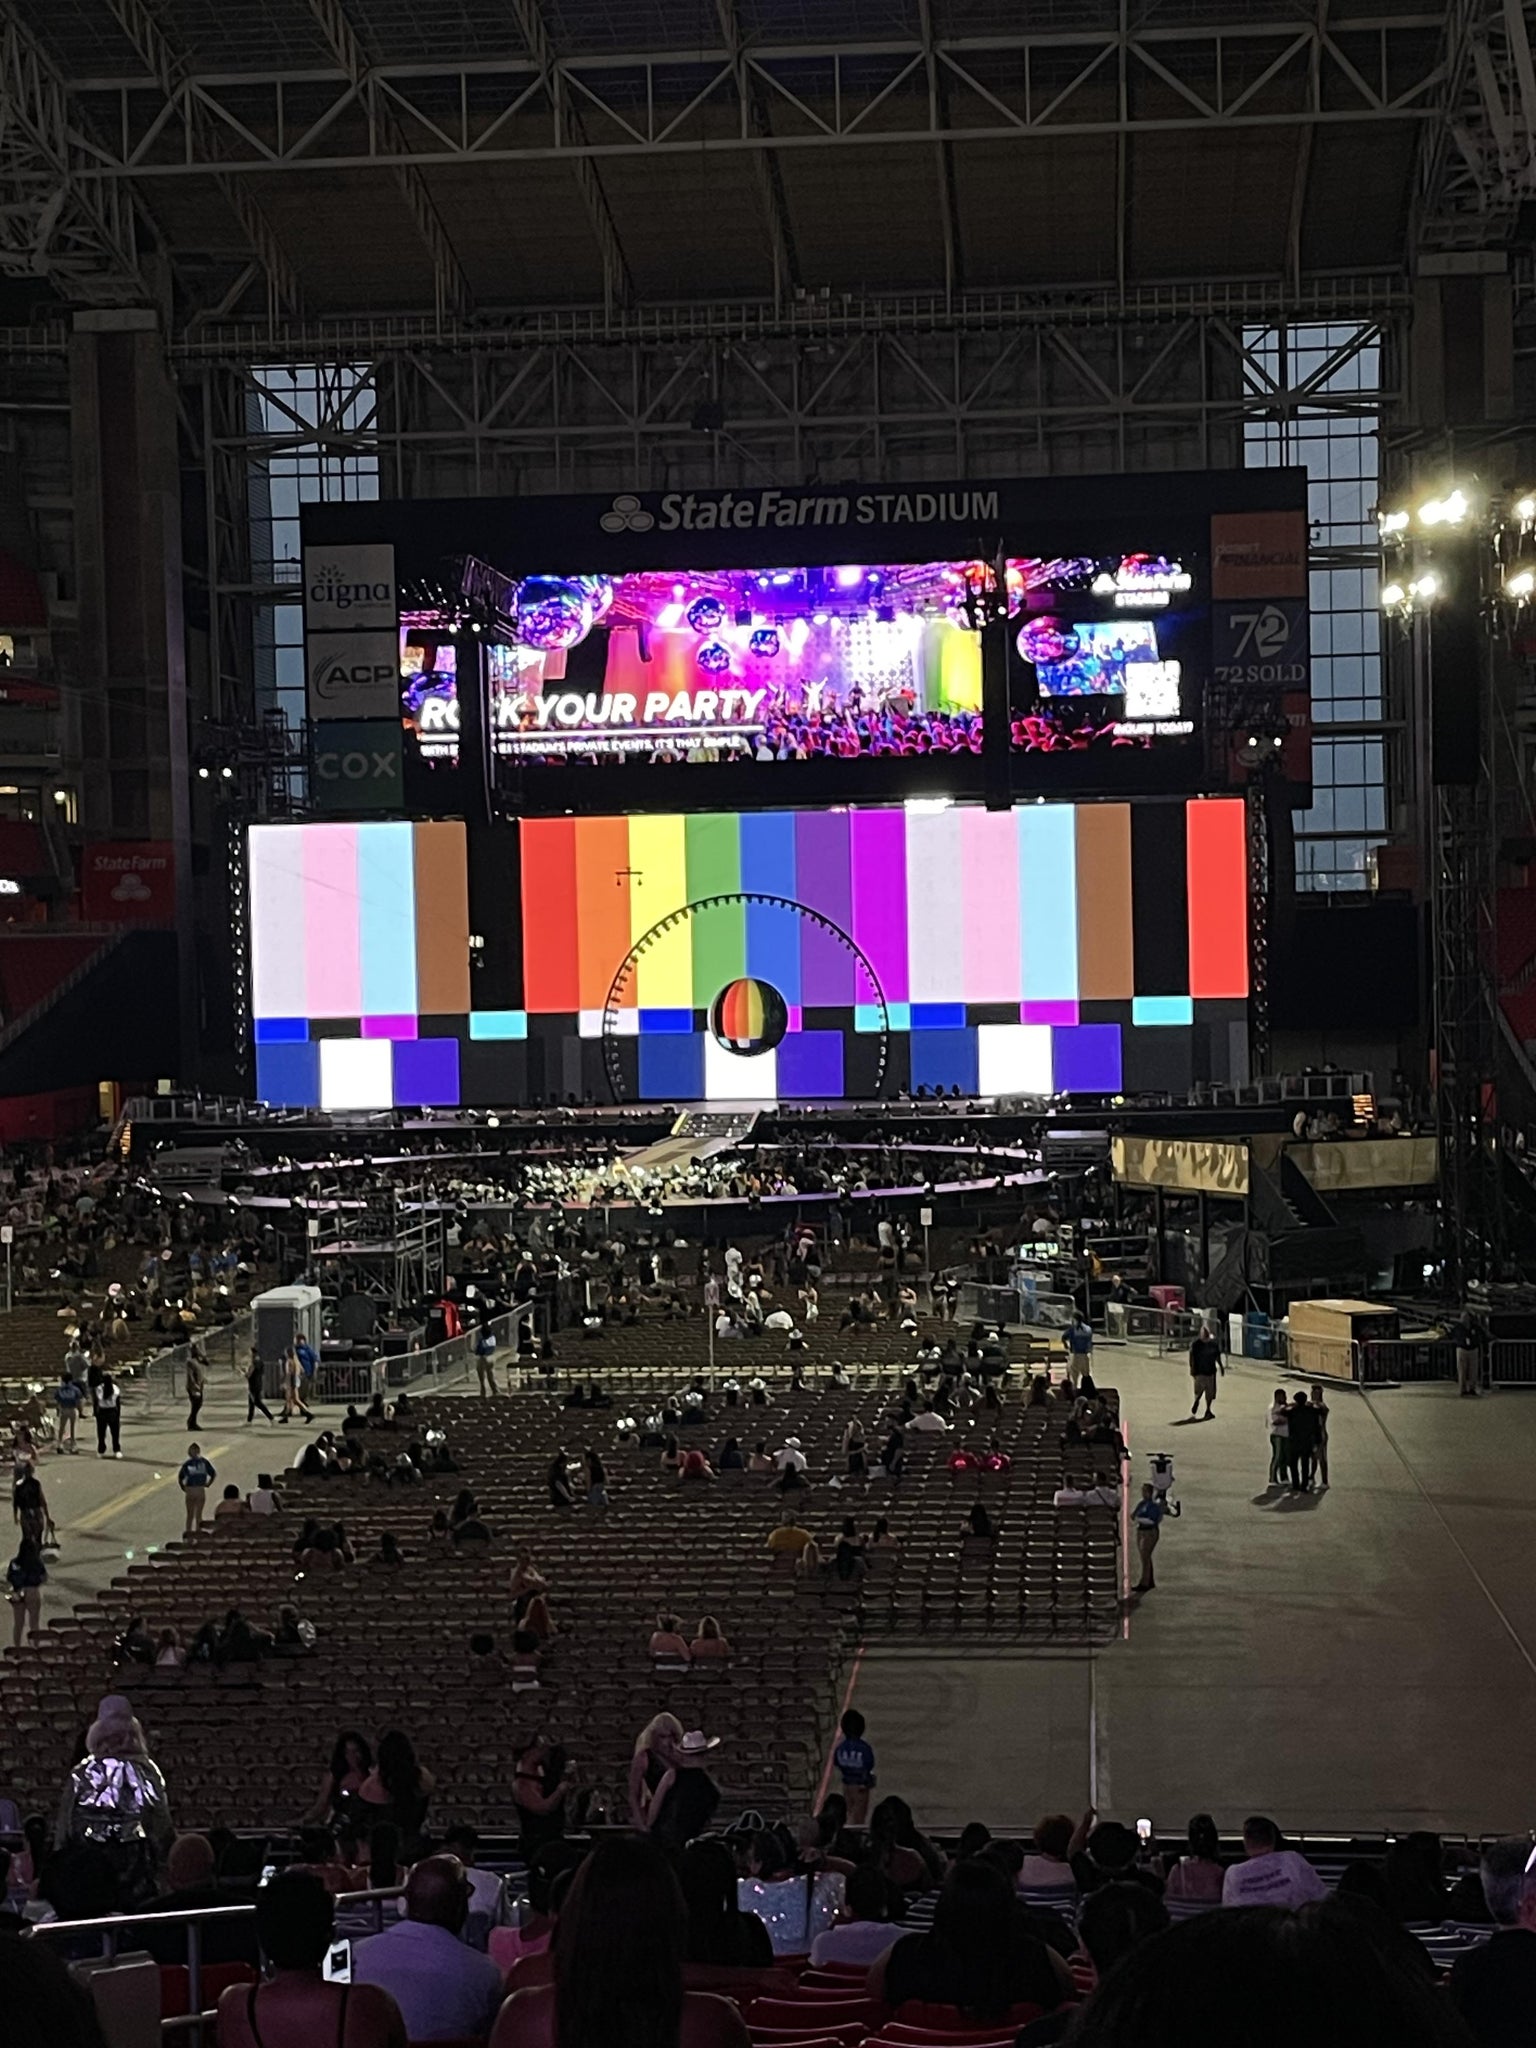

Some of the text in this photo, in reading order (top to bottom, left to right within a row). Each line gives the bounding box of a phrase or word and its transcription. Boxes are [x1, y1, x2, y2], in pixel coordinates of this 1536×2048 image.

[855, 492, 999, 524] STADIUM
[310, 578, 391, 610] cigna
[1230, 612, 1289, 659] 72
[326, 665, 394, 685] ACP
[534, 692, 637, 726] YOUR
[643, 689, 767, 723] PARTY
[567, 741, 610, 752] PRIVATE
[675, 738, 701, 748] THAT
[318, 751, 396, 780] COX
